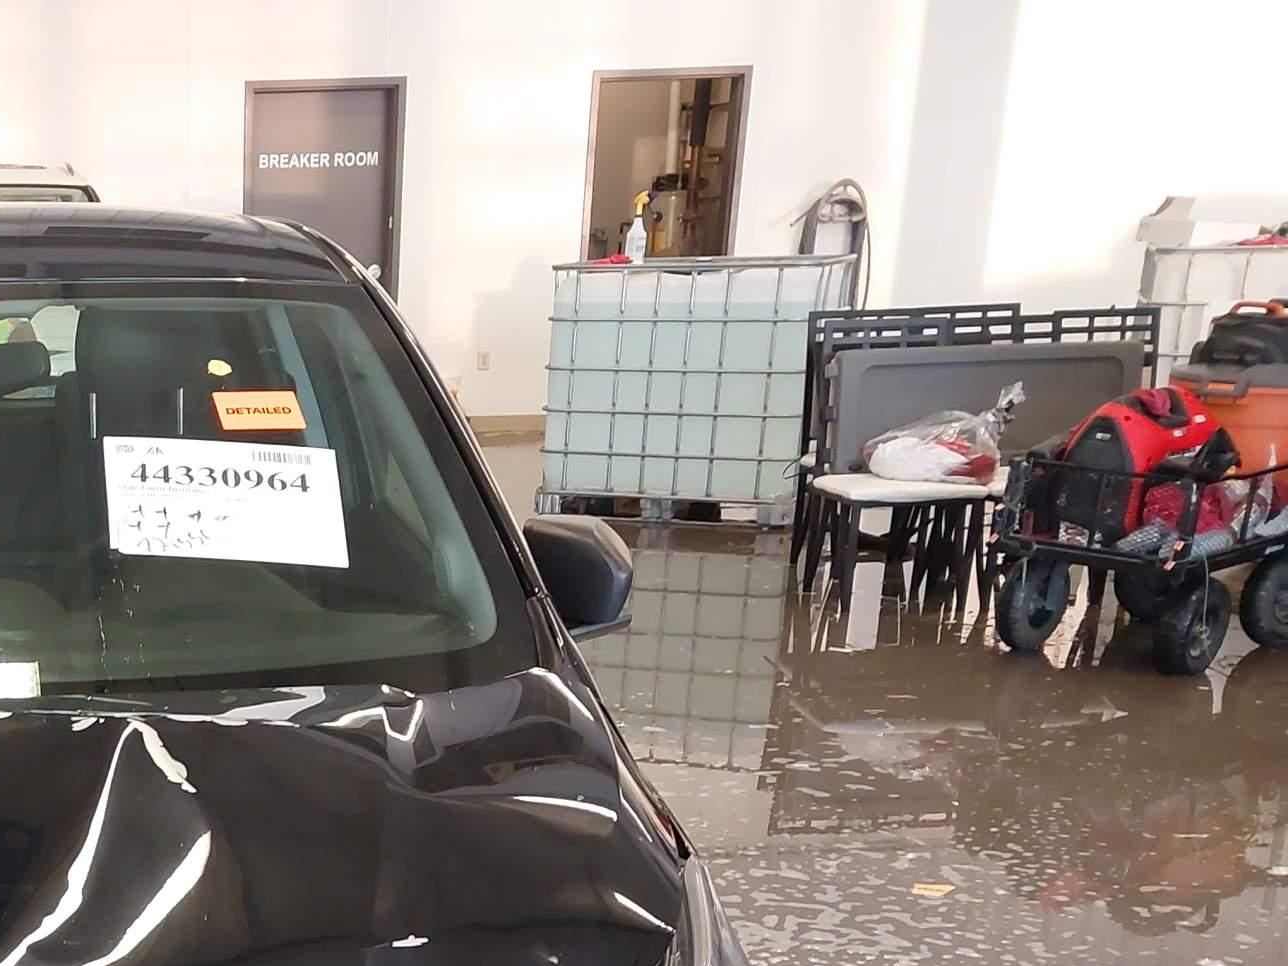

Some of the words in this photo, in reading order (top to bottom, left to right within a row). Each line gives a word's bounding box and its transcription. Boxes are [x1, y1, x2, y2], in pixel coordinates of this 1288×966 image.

[258, 153, 330, 169] BREAKER
[333, 151, 379, 167] ROOM
[225, 406, 293, 416] DETAILED
[130, 462, 311, 493] 44330964
